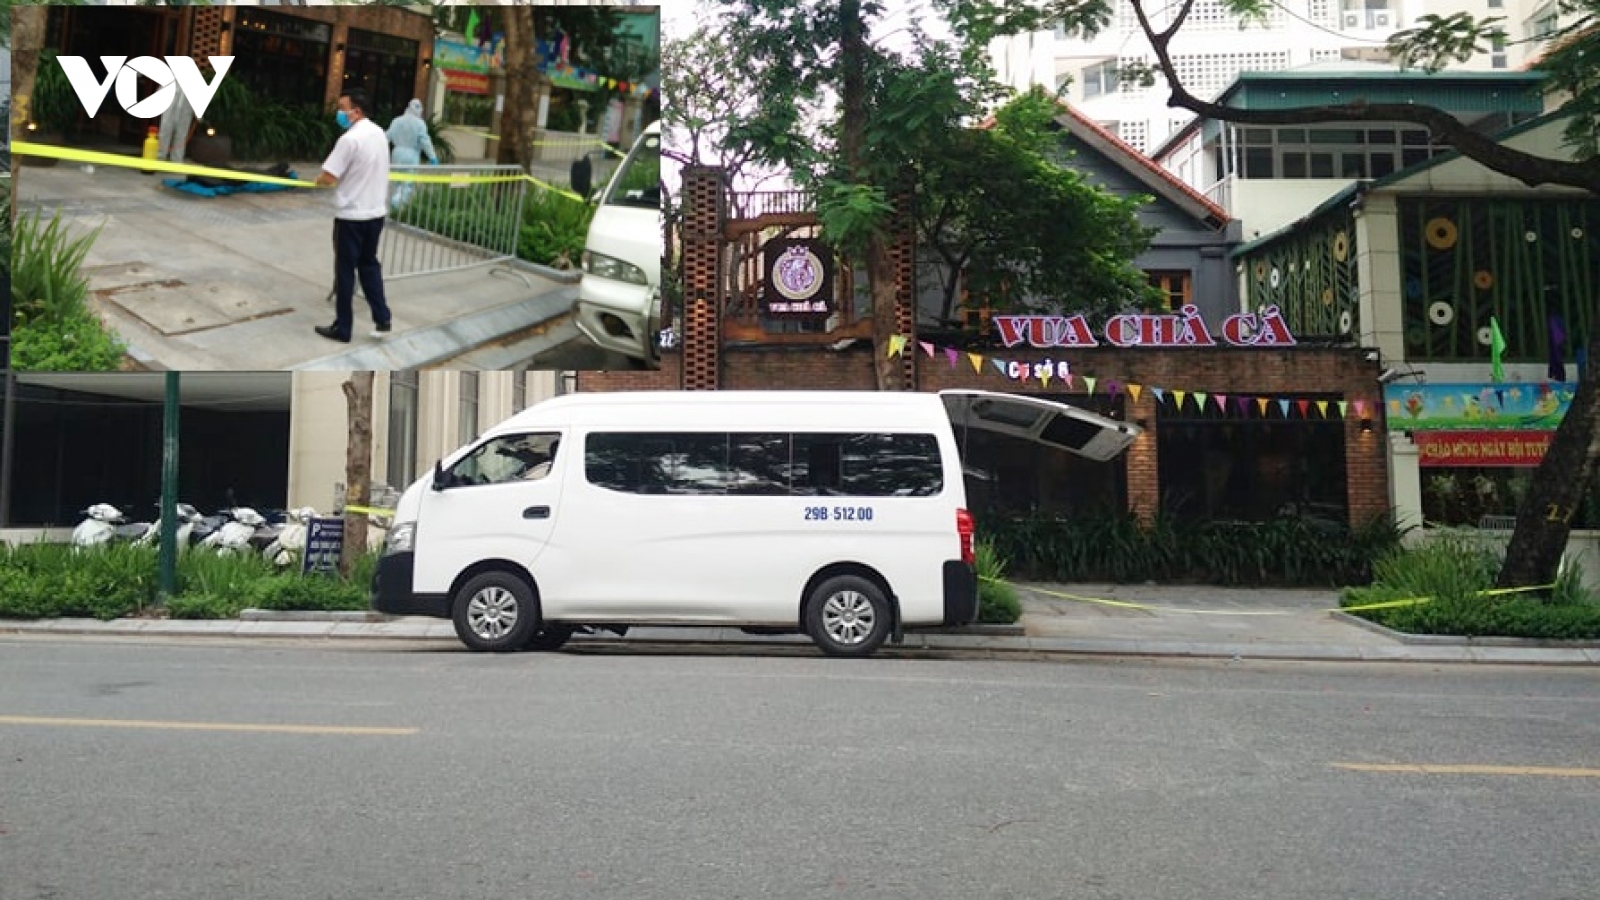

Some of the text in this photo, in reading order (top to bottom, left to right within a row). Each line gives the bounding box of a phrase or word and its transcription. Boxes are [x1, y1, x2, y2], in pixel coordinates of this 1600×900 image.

[993, 304, 1296, 347] VUA CHẢ CÁ
